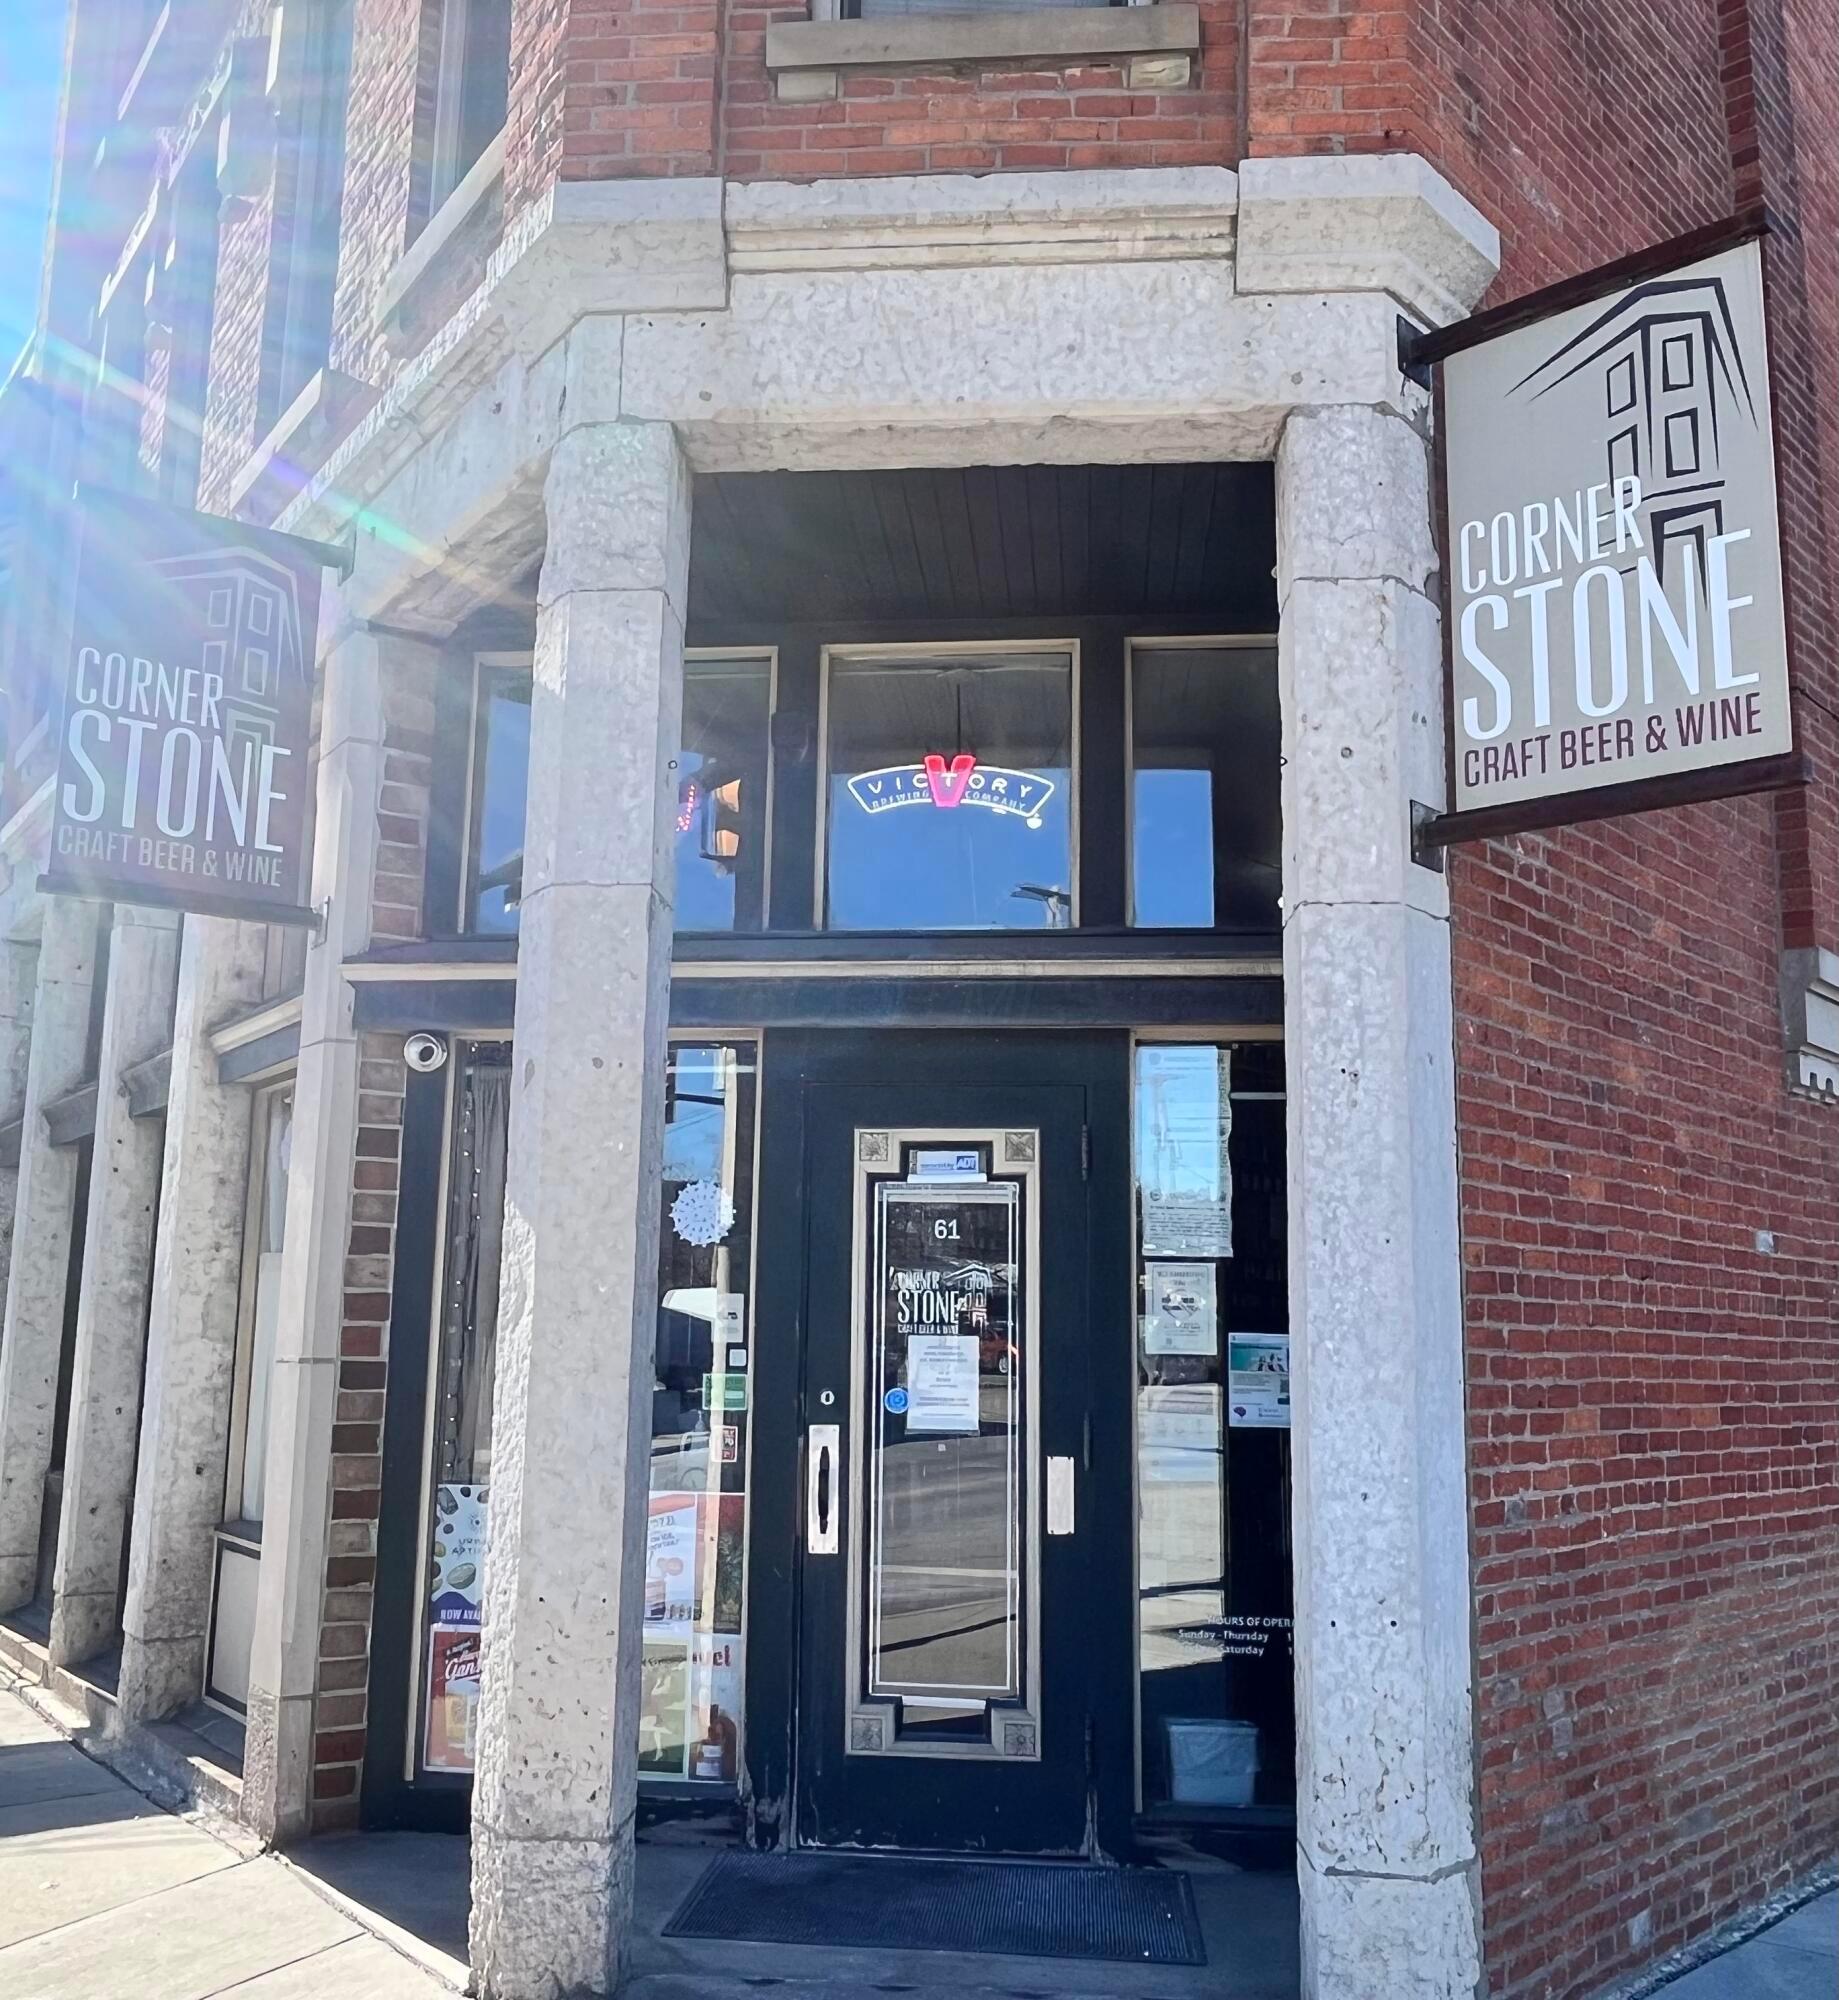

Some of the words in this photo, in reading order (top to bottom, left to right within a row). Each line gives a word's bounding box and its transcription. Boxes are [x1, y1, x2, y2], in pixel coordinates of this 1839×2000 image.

[1460, 475, 1644, 595] CORNER
[1460, 528, 1761, 741] STONE
[75, 647, 224, 729] CORNER
[1464, 735, 1550, 788] CRAFT
[1560, 717, 1635, 771] BEER
[1646, 714, 1668, 753] &
[1676, 691, 1763, 747] WINE
[62, 709, 292, 853] STONE
[868, 773, 1032, 798] VICTORY
[57, 825, 133, 863] CRAFT
[138, 837, 195, 874] BEER
[202, 850, 218, 877] &
[225, 852, 282, 887] WINE
[957, 1157, 976, 1169] ADT
[935, 1219, 960, 1239] 61
[897, 1290, 960, 1324] STONE
[1178, 1629, 1215, 1640] Sunday
[1224, 1630, 1269, 1643] Thursday
[1208, 1616, 1244, 1626] HOURS
[1247, 1617, 1261, 1626] OF
[1220, 1643, 1264, 1656] Saturday
